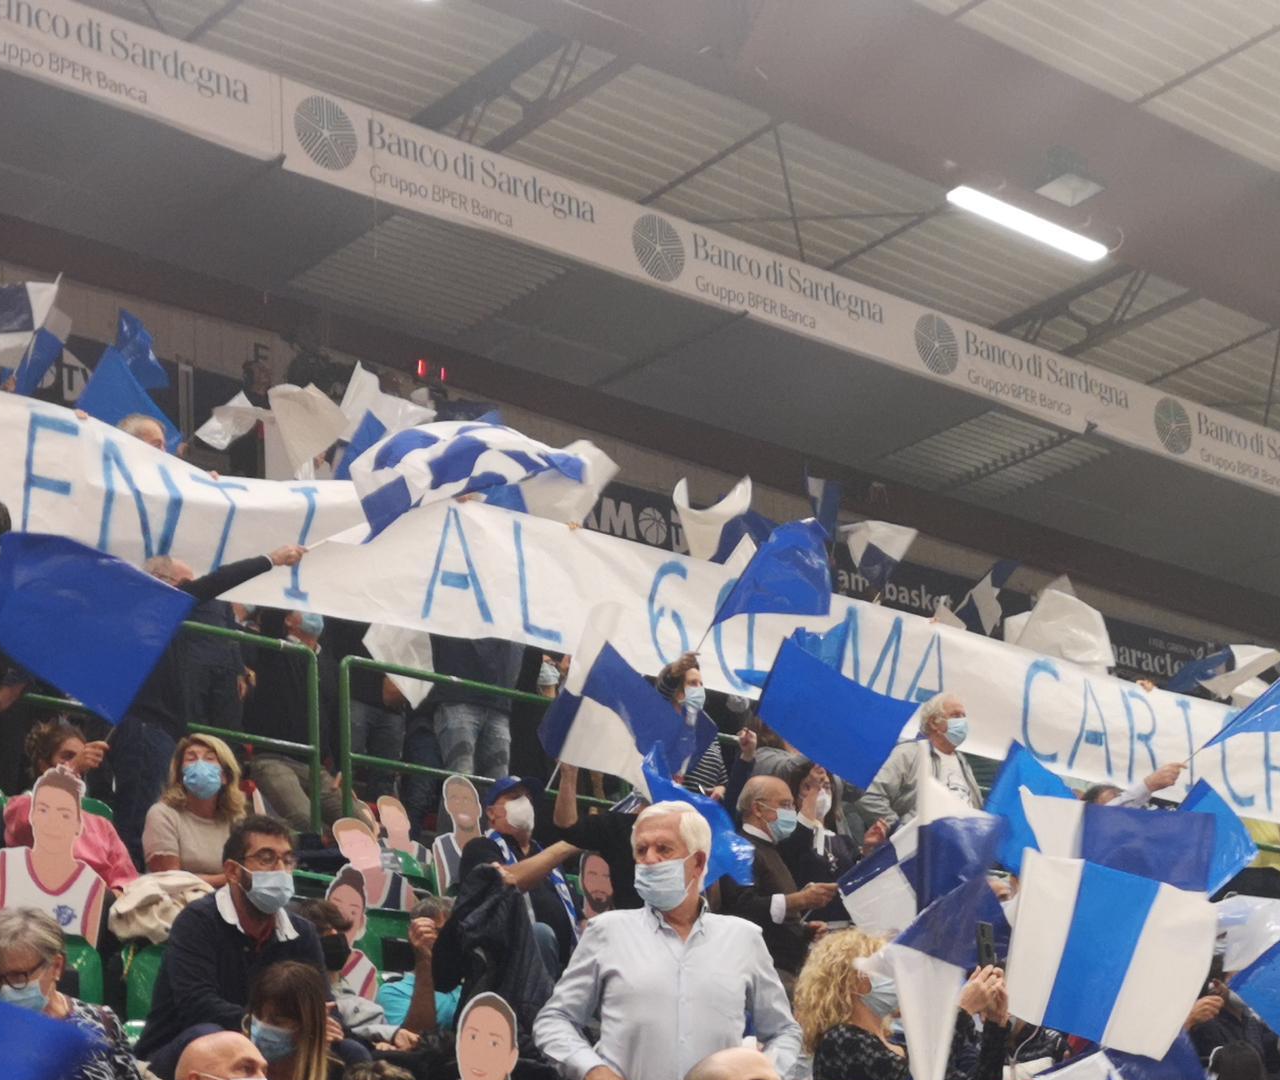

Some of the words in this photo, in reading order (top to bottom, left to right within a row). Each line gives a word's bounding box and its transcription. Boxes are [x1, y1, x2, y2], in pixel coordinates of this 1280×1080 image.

[48, 54, 93, 84] BPER
[96, 71, 148, 104] Banca
[367, 118, 449, 172] Banco
[453, 153, 476, 183] di
[480, 159, 596, 224] Sardegna
[369, 164, 428, 199] Gruppo
[431, 184, 468, 212] BPER
[471, 197, 514, 229] Banca
[692, 232, 762, 281] Banco
[765, 260, 784, 288] di
[788, 266, 884, 325] Sardegna
[695, 275, 745, 306] Gruppo
[747, 291, 779, 318] BPER
[780, 303, 817, 330] Banca
[965, 330, 1024, 372] Banco
[1026, 354, 1043, 379] di
[1046, 358, 1129, 409] Sardegna
[967, 369, 1010, 397] Gruppo
[1011, 384, 1037, 405] BPER
[1039, 394, 1072, 416] Banca
[1197, 411, 1248, 451] Banco
[1250, 432, 1264, 455] di
[421, 505, 563, 644] AL
